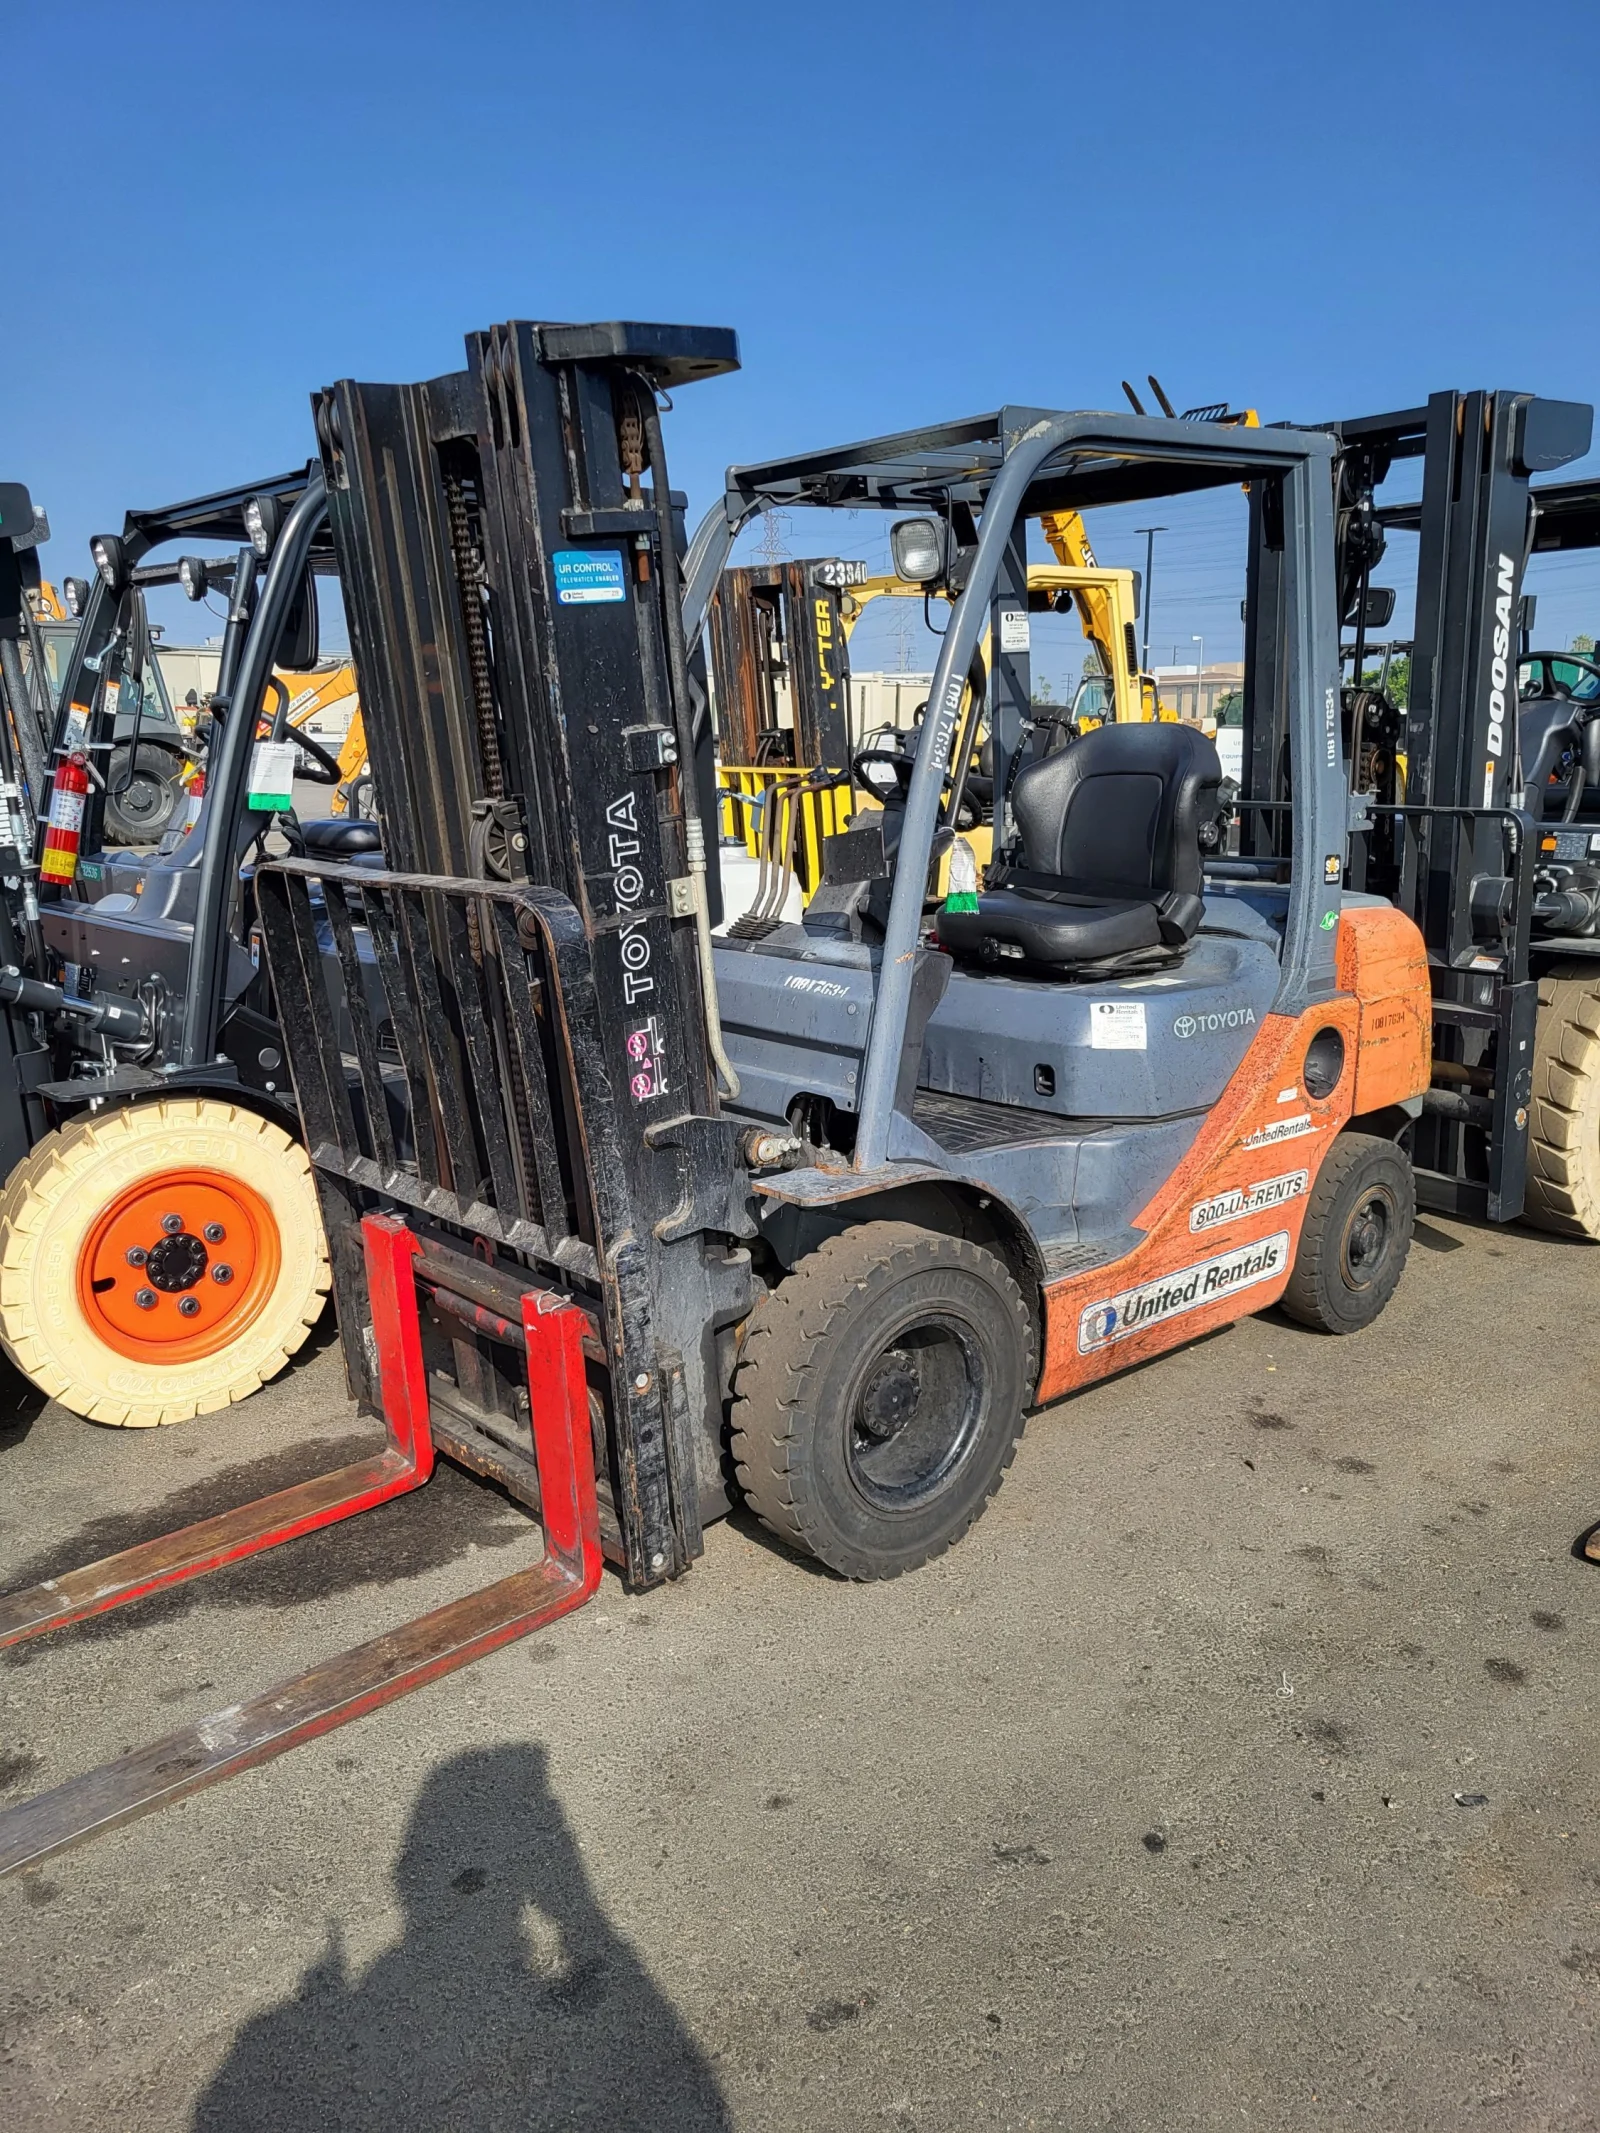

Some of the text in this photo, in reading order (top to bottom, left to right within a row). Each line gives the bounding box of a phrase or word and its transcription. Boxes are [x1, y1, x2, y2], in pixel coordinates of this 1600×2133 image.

[558, 562, 613, 574] UR CONTROL
[560, 574, 620, 584] TELEMATICS ENABLED
[1486, 552, 1514, 757] DOOSAN
[930, 673, 965, 771] 10817634
[1325, 687, 1336, 768] 10817634
[606, 791, 654, 1005] TOYOTA
[1197, 1008, 1256, 1032] TOYOTA
[1371, 1011, 1405, 1032] 10817634
[107, 1137, 234, 1179] NEXEN
[1196, 1176, 1303, 1226] 800-UR-RENTS
[1121, 1245, 1278, 1327] United Rentals
